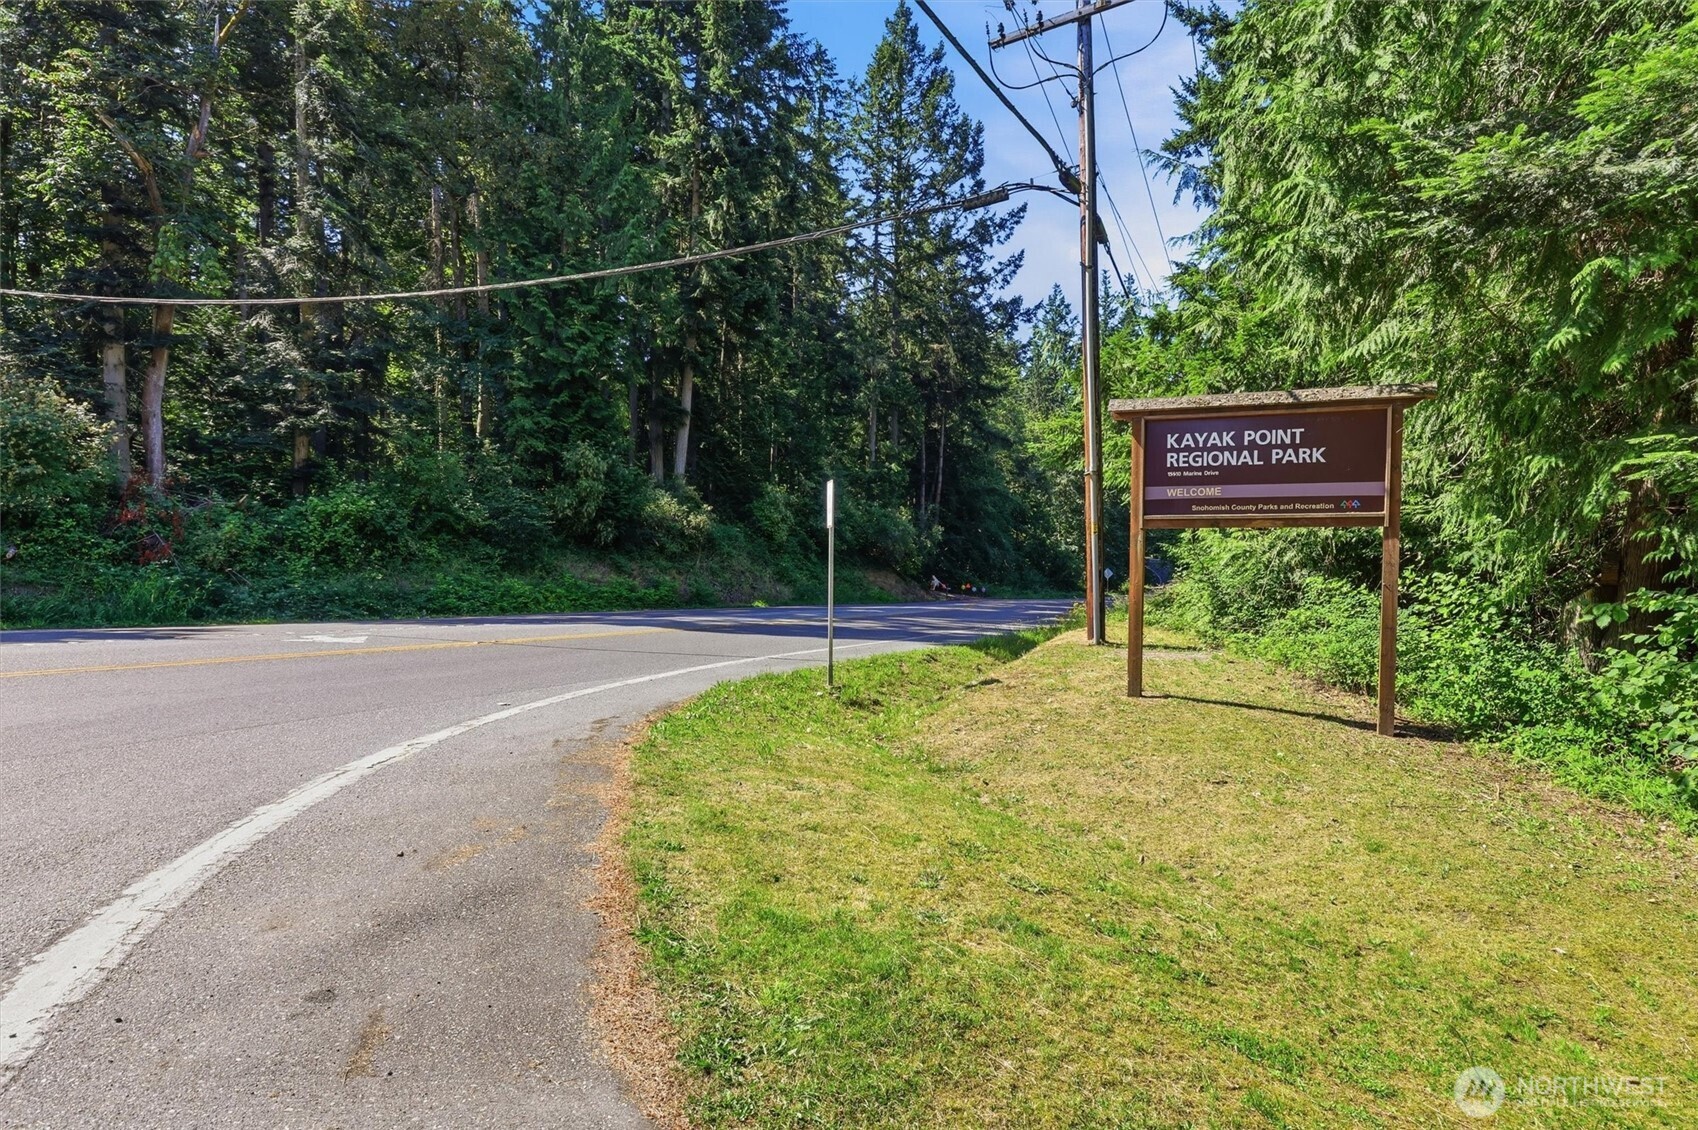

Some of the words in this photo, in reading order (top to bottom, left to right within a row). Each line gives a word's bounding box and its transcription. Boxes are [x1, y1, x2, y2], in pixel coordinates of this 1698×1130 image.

[1167, 431, 1235, 448] KAYAK
[1244, 428, 1304, 445] POINT
[1167, 450, 1264, 467] REGIONAL
[1272, 447, 1326, 464] PARK
[1167, 487, 1222, 496] WELCOME
[1231, 504, 1256, 512] County
